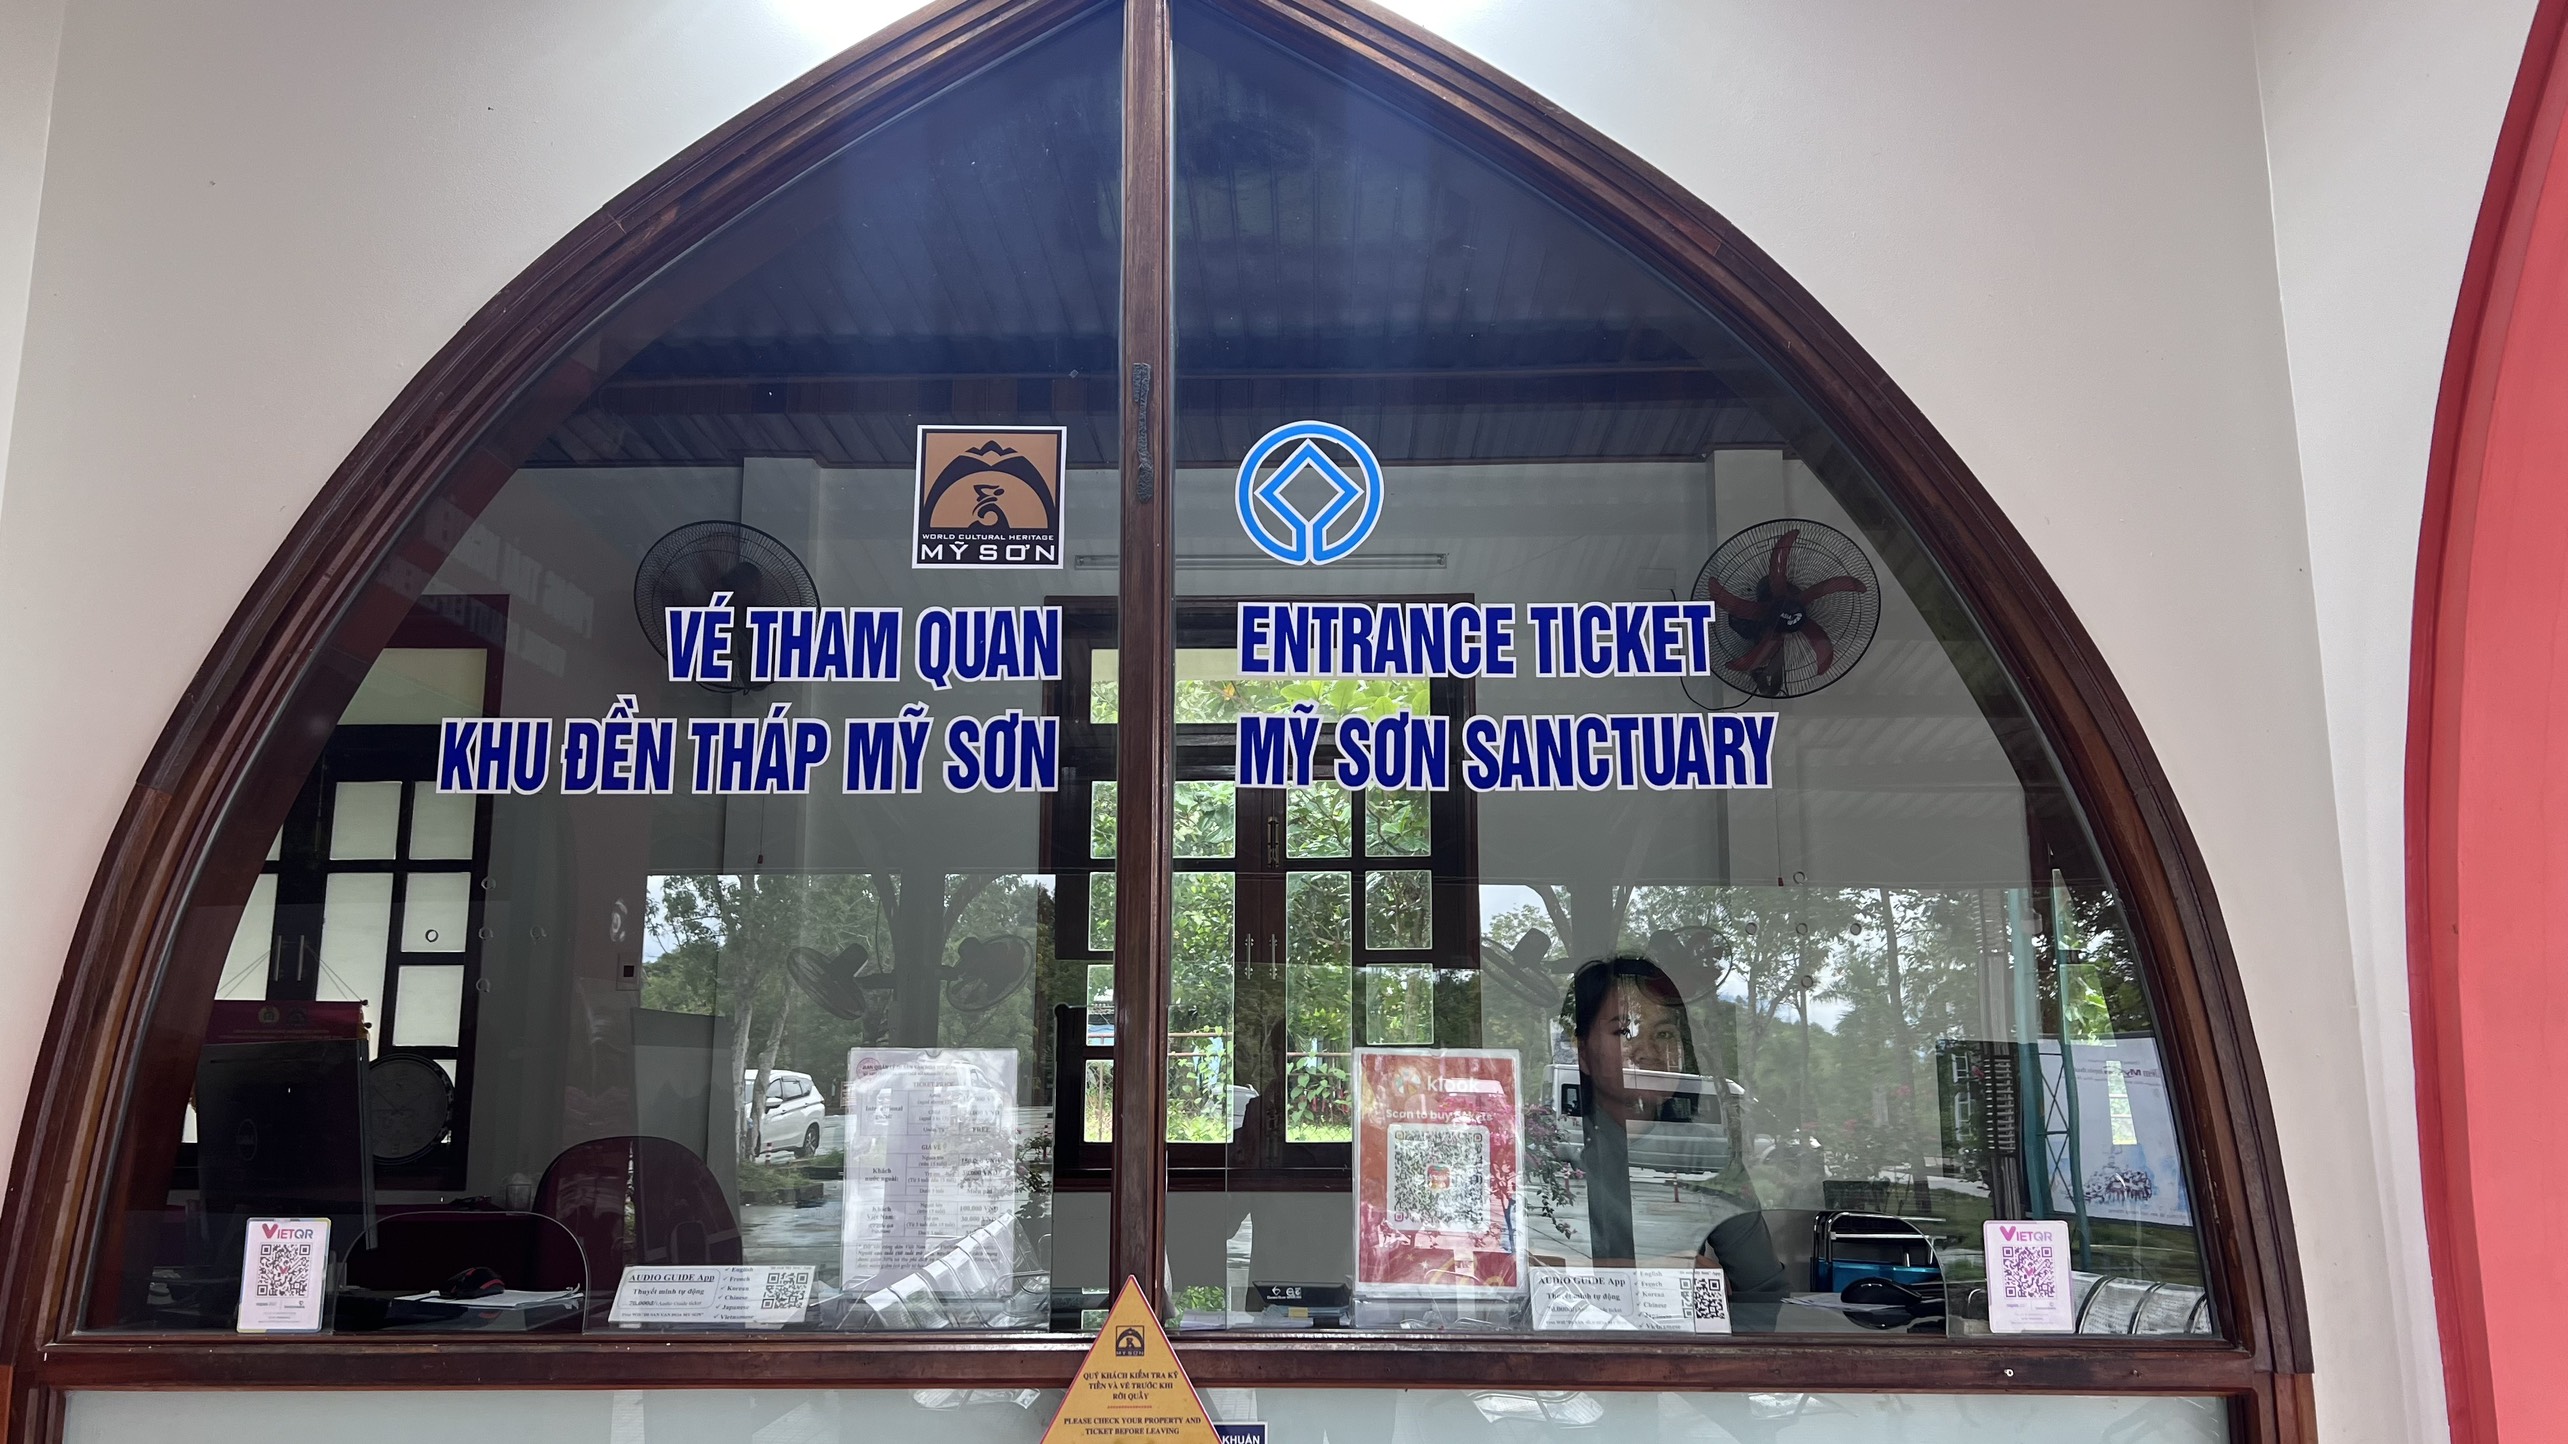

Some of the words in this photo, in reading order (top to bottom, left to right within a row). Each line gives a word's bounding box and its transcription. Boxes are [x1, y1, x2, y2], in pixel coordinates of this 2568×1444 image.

[922, 533, 956, 541] WORLD
[958, 533, 1006, 541] CULTURAL
[1008, 533, 1055, 541] HERITAGE
[921, 541, 969, 561] MỸ
[978, 543, 1056, 562] SƠN
[664, 591, 733, 682] VÉ
[746, 606, 904, 682] THAM
[914, 605, 1063, 691] QUAN
[1237, 601, 1518, 678] ENTRANCE
[1527, 600, 1716, 678] TICKET
[436, 717, 553, 796] KHU
[560, 693, 677, 796] ĐỀN
[687, 702, 831, 795] THÁP
[842, 701, 935, 795] MỸ
[943, 708, 1060, 794] SƠN
[1236, 699, 1322, 789] MỸ
[1333, 708, 1451, 791] SƠN
[1461, 711, 1780, 792] SANCTUARY
[1427, 1075, 1479, 1093] klook
[1386, 1108, 1414, 1121] Scan
[1415, 1109, 1427, 1121] to
[1429, 1108, 1450, 1123] buy
[261, 1223, 314, 1239] VIETQR
[2000, 1225, 2053, 1242] VIETQR
[731, 1266, 754, 1274] English
[628, 1274, 661, 1282] AUDIO
[663, 1274, 696, 1282] GUIDE
[697, 1274, 716, 1283] App
[1608, 1277, 1626, 1287] App
[633, 1286, 657, 1296] Thuyết
[687, 1287, 705, 1296] động
[1603, 1292, 1621, 1301] động
[722, 1304, 750, 1312] Japanese
[1101, 1371, 1129, 1380] KHÁCH
[1130, 1368, 1149, 1380] KIỂM
[1151, 1372, 1166, 1380] TRA
[1108, 1382, 1119, 1390] VÀ
[1159, 1382, 1173, 1390] KHI
[1063, 1417, 1093, 1426] PLEASE
[1093, 1417, 1120, 1426] CHECK
[1121, 1417, 1142, 1425] YOUR
[1144, 1416, 1184, 1425] PROPERTY
[1185, 1416, 1202, 1425] AND
[1085, 1427, 1113, 1435] TICKET
[1114, 1427, 1144, 1435] BEFORE
[1145, 1426, 1180, 1435] LEAVING
